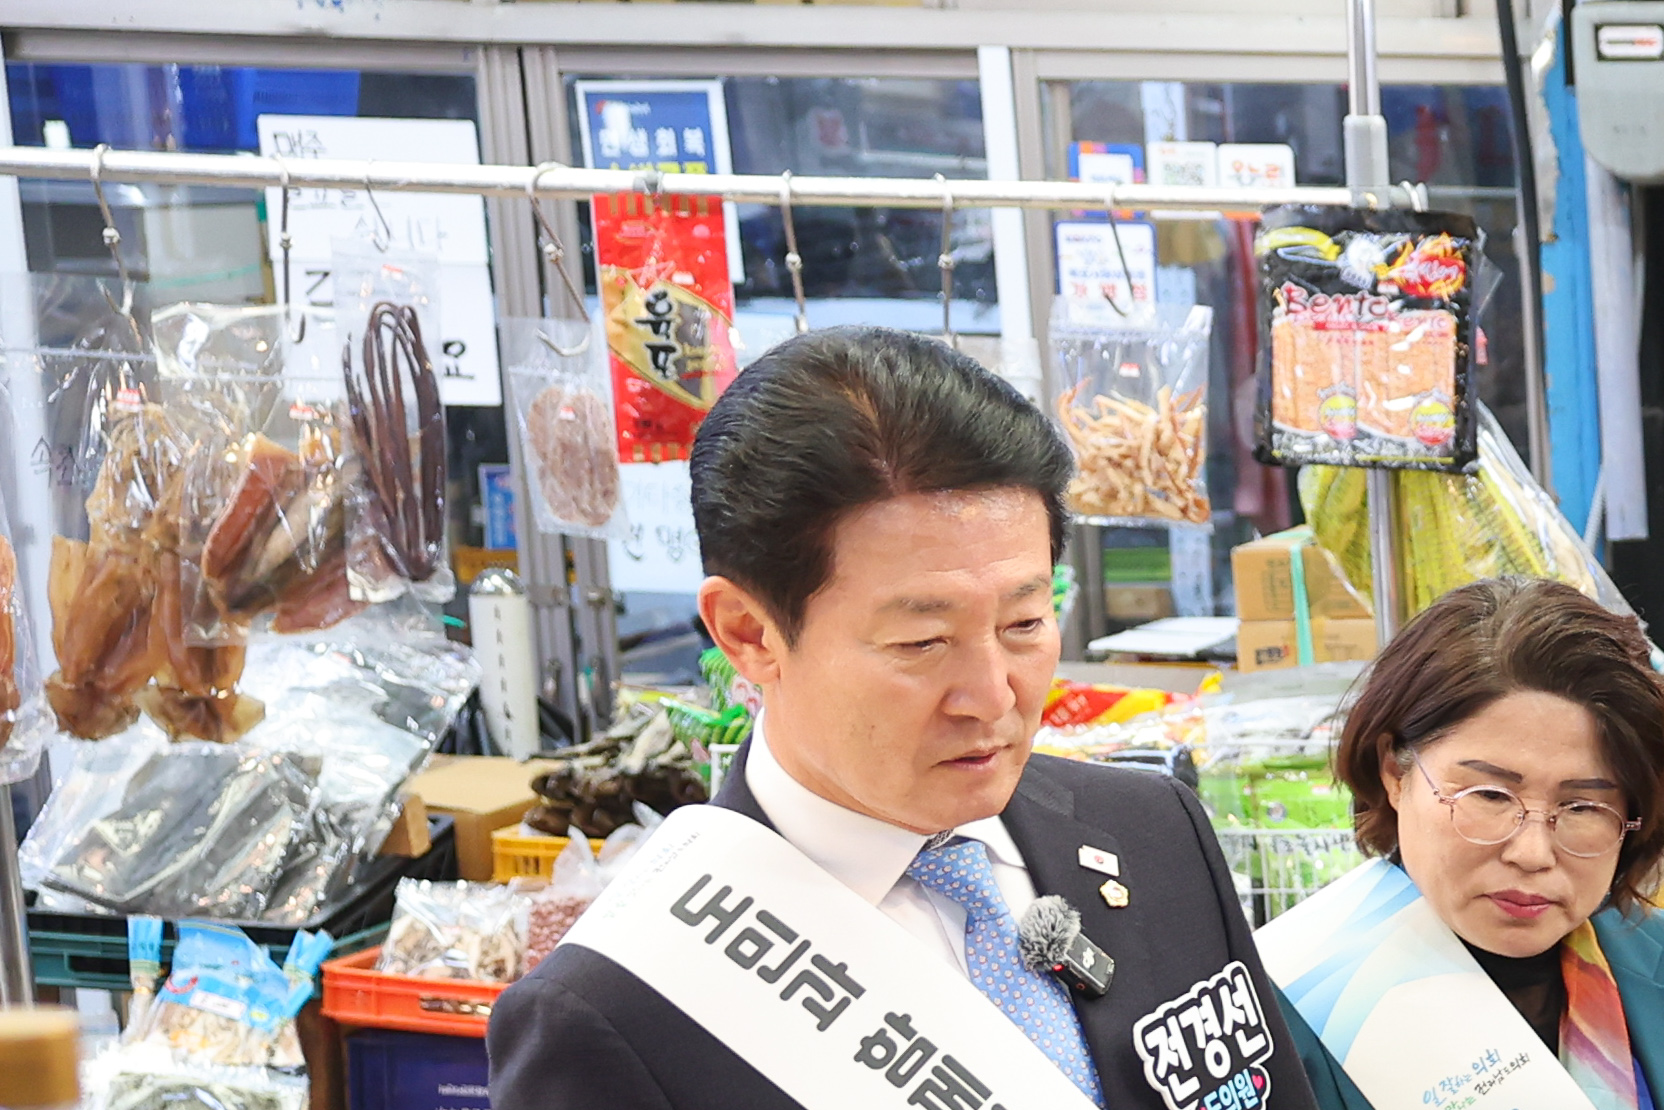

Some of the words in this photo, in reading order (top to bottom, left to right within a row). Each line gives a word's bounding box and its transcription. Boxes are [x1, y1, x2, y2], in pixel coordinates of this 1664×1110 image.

[1280, 282, 1389, 319] Bento
[670, 873, 866, 1031] 도민과
[1145, 974, 1266, 1101] 전경선
[1423, 1086, 1447, 1107] 일
[1439, 1074, 1472, 1095] 잘하는
[1472, 1049, 1501, 1075] 의회
[1474, 1053, 1530, 1095] 전라남도의회
